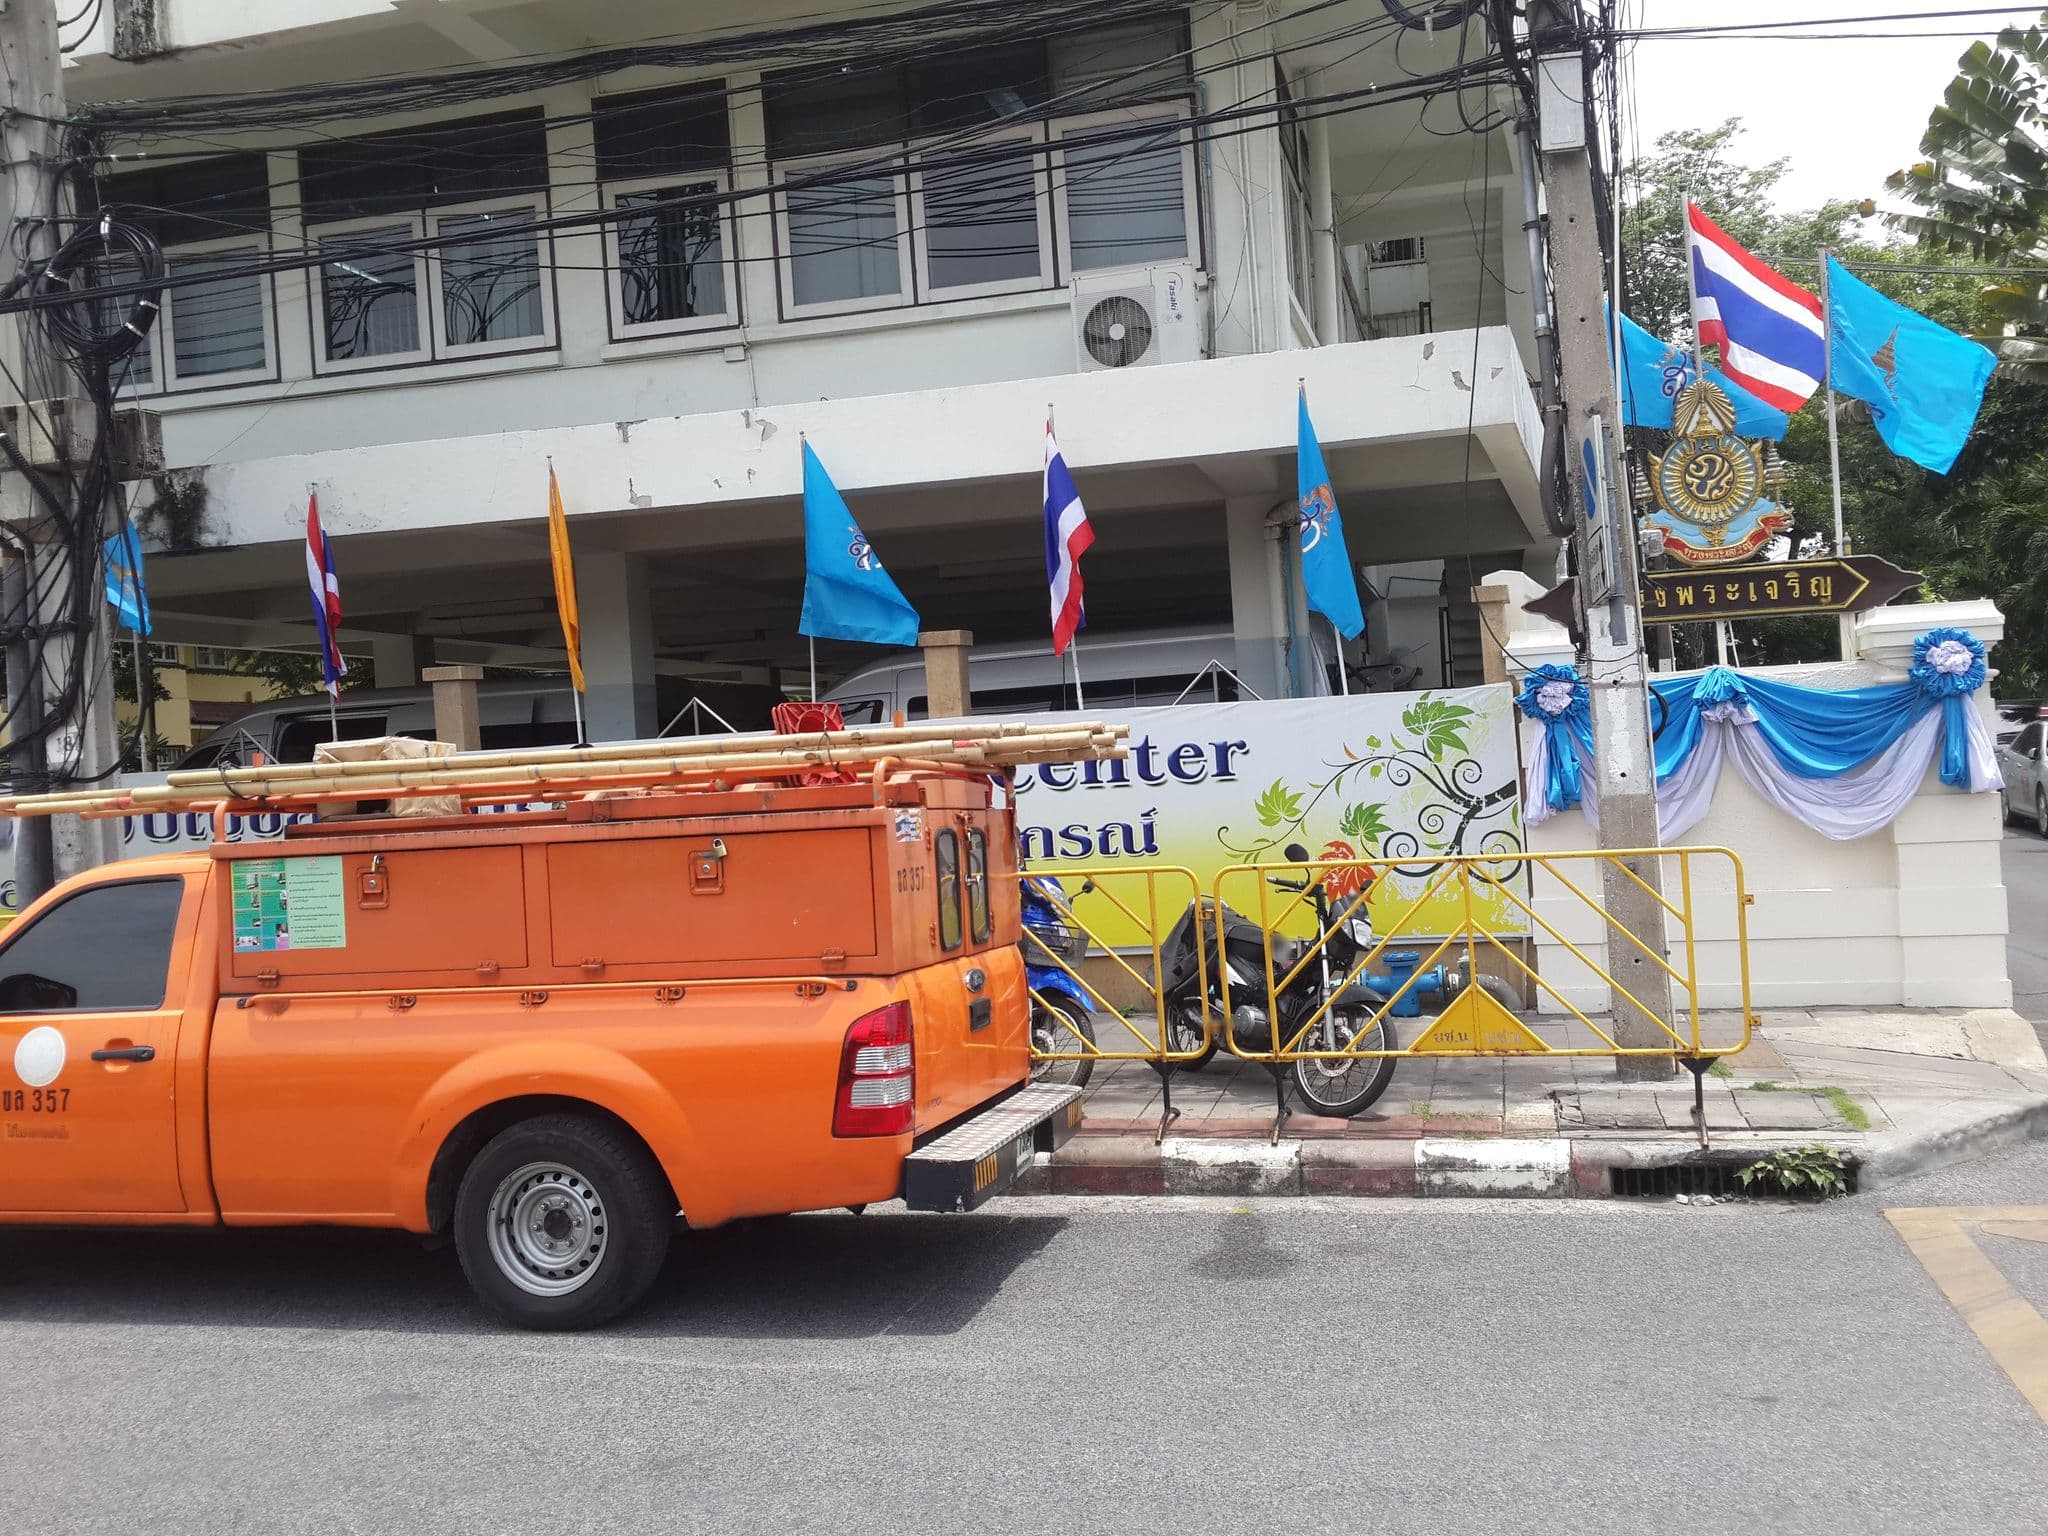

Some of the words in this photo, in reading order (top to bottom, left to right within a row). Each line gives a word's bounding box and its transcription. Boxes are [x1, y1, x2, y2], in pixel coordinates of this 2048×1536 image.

[1168, 280, 1179, 311] Tasaki
[910, 866, 925, 891] 357
[32, 1088, 71, 1113] 357
